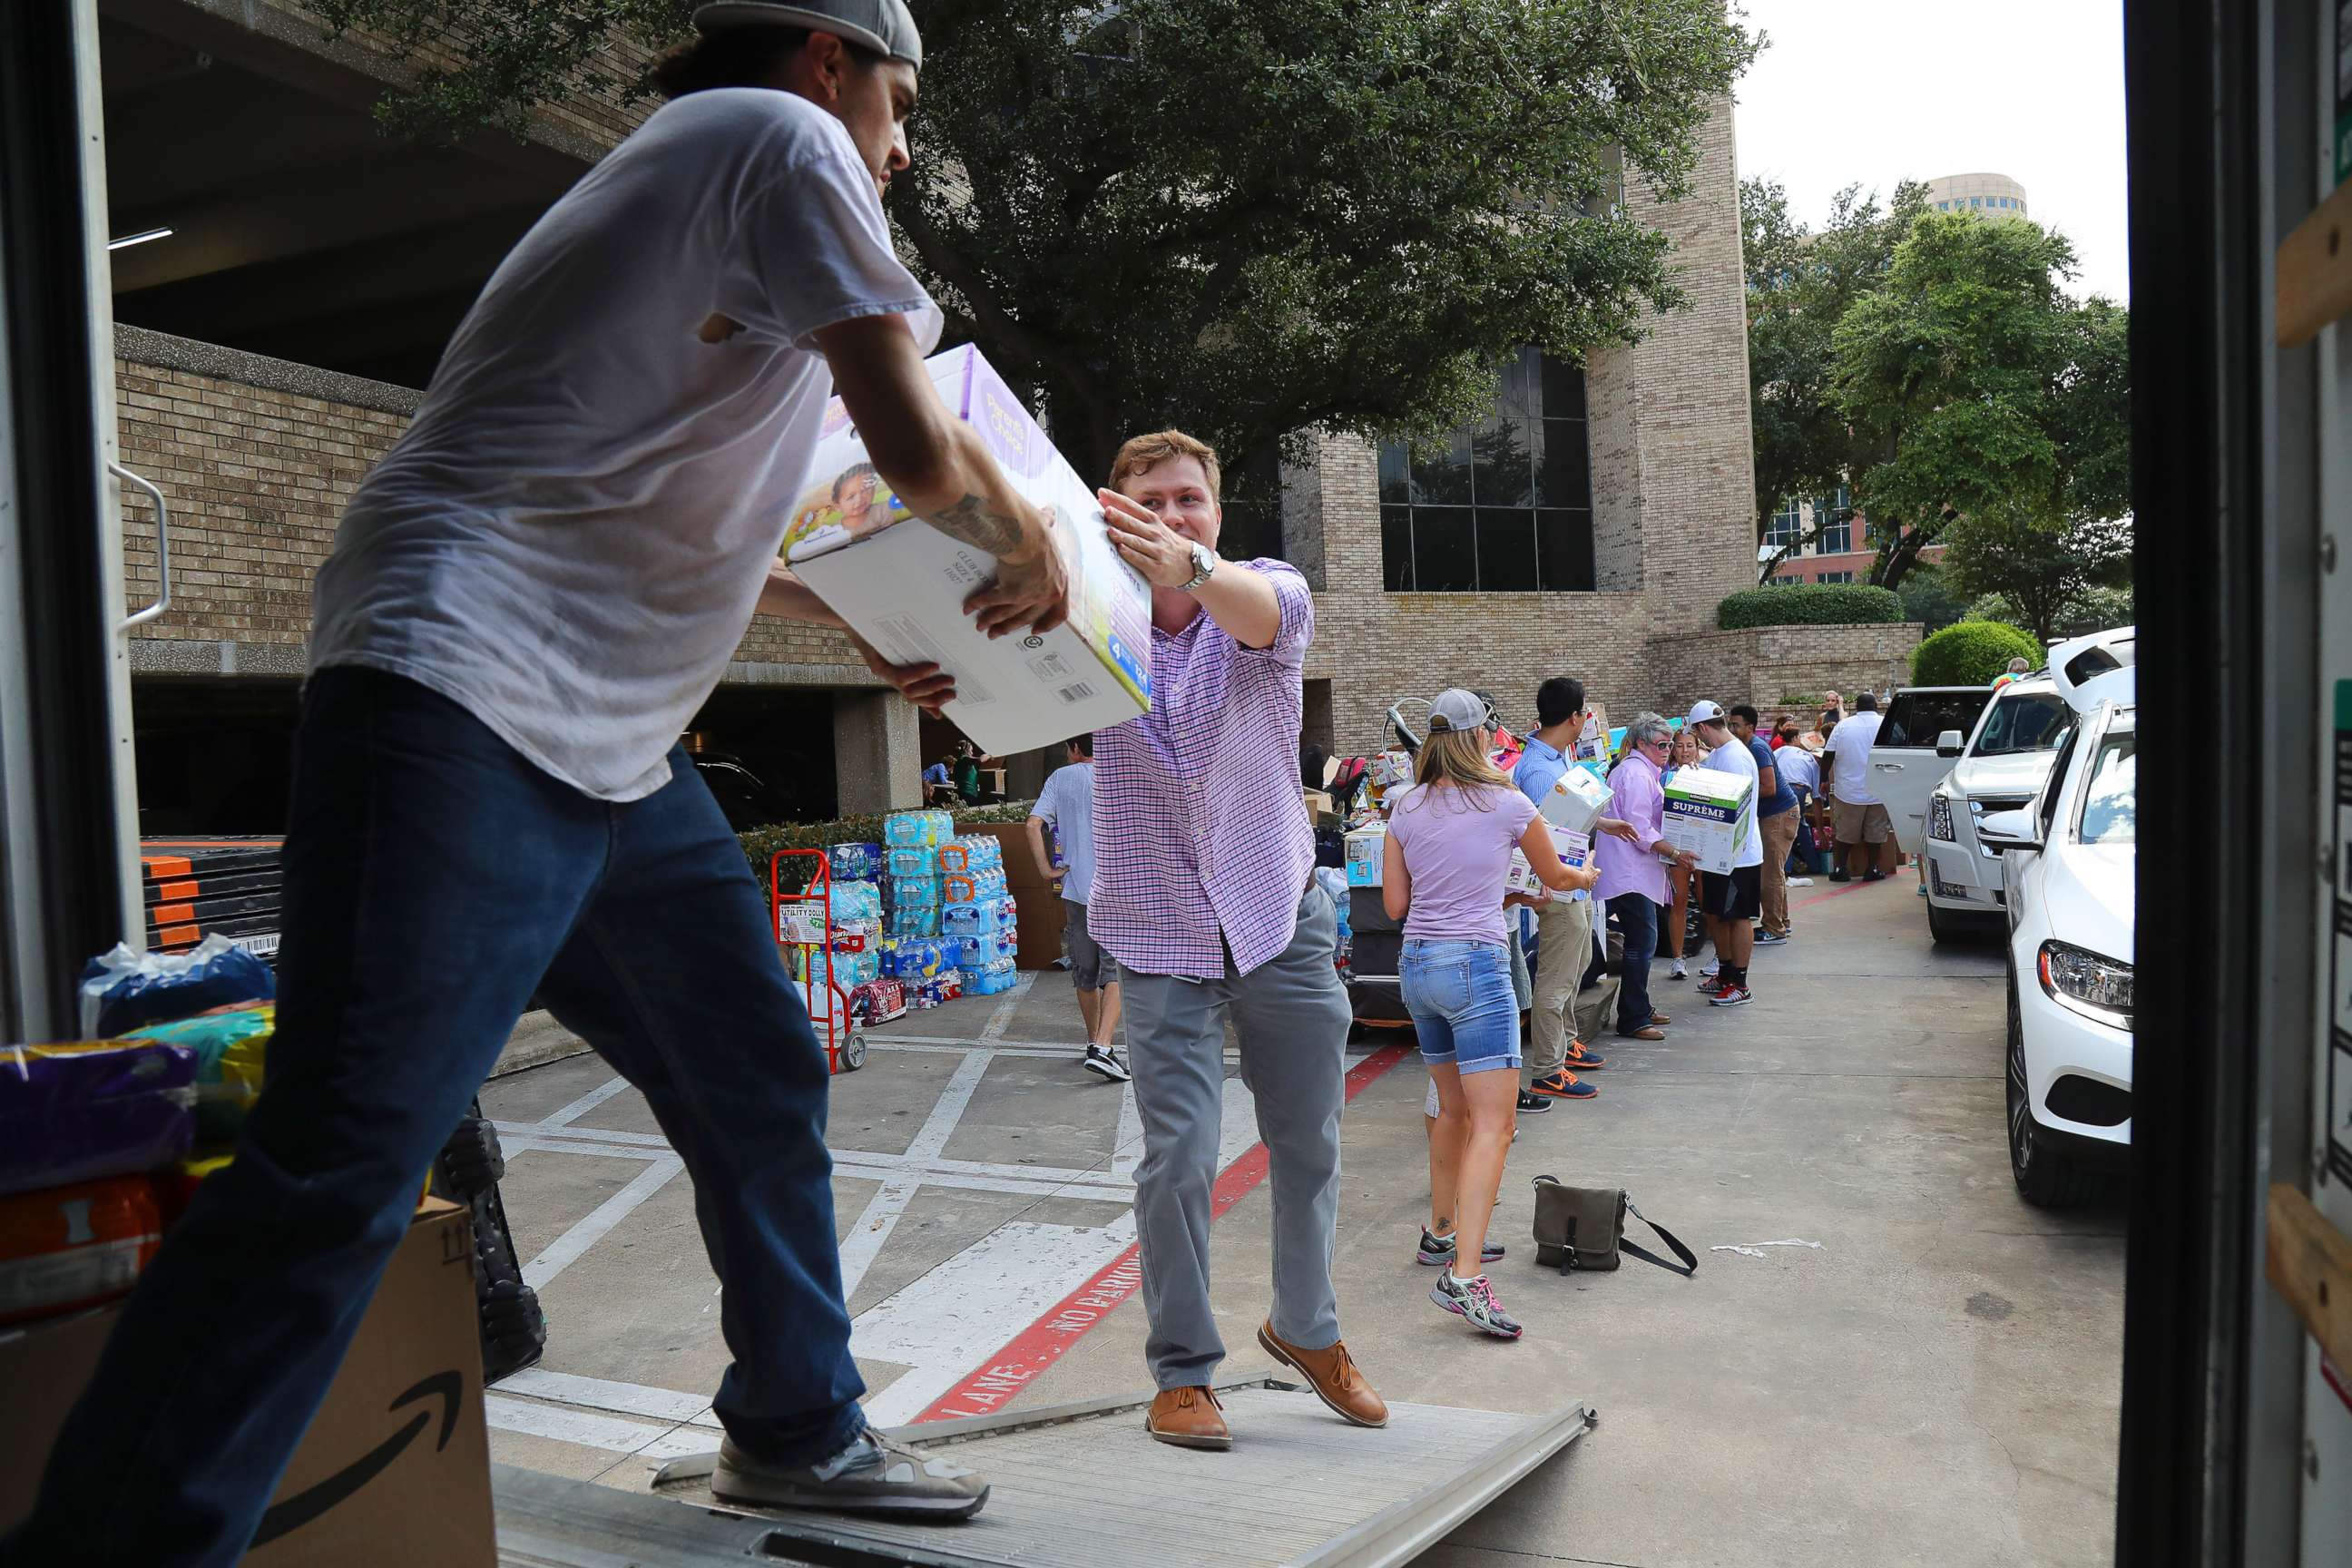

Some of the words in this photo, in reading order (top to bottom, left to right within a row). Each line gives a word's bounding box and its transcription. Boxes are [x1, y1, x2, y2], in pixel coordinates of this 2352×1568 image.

[1112, 642, 1122, 660] 4
[940, 1363, 1034, 1416] LANE
[1044, 1308, 1098, 1333] NO
[1073, 1250, 1142, 1308] PARKIN
